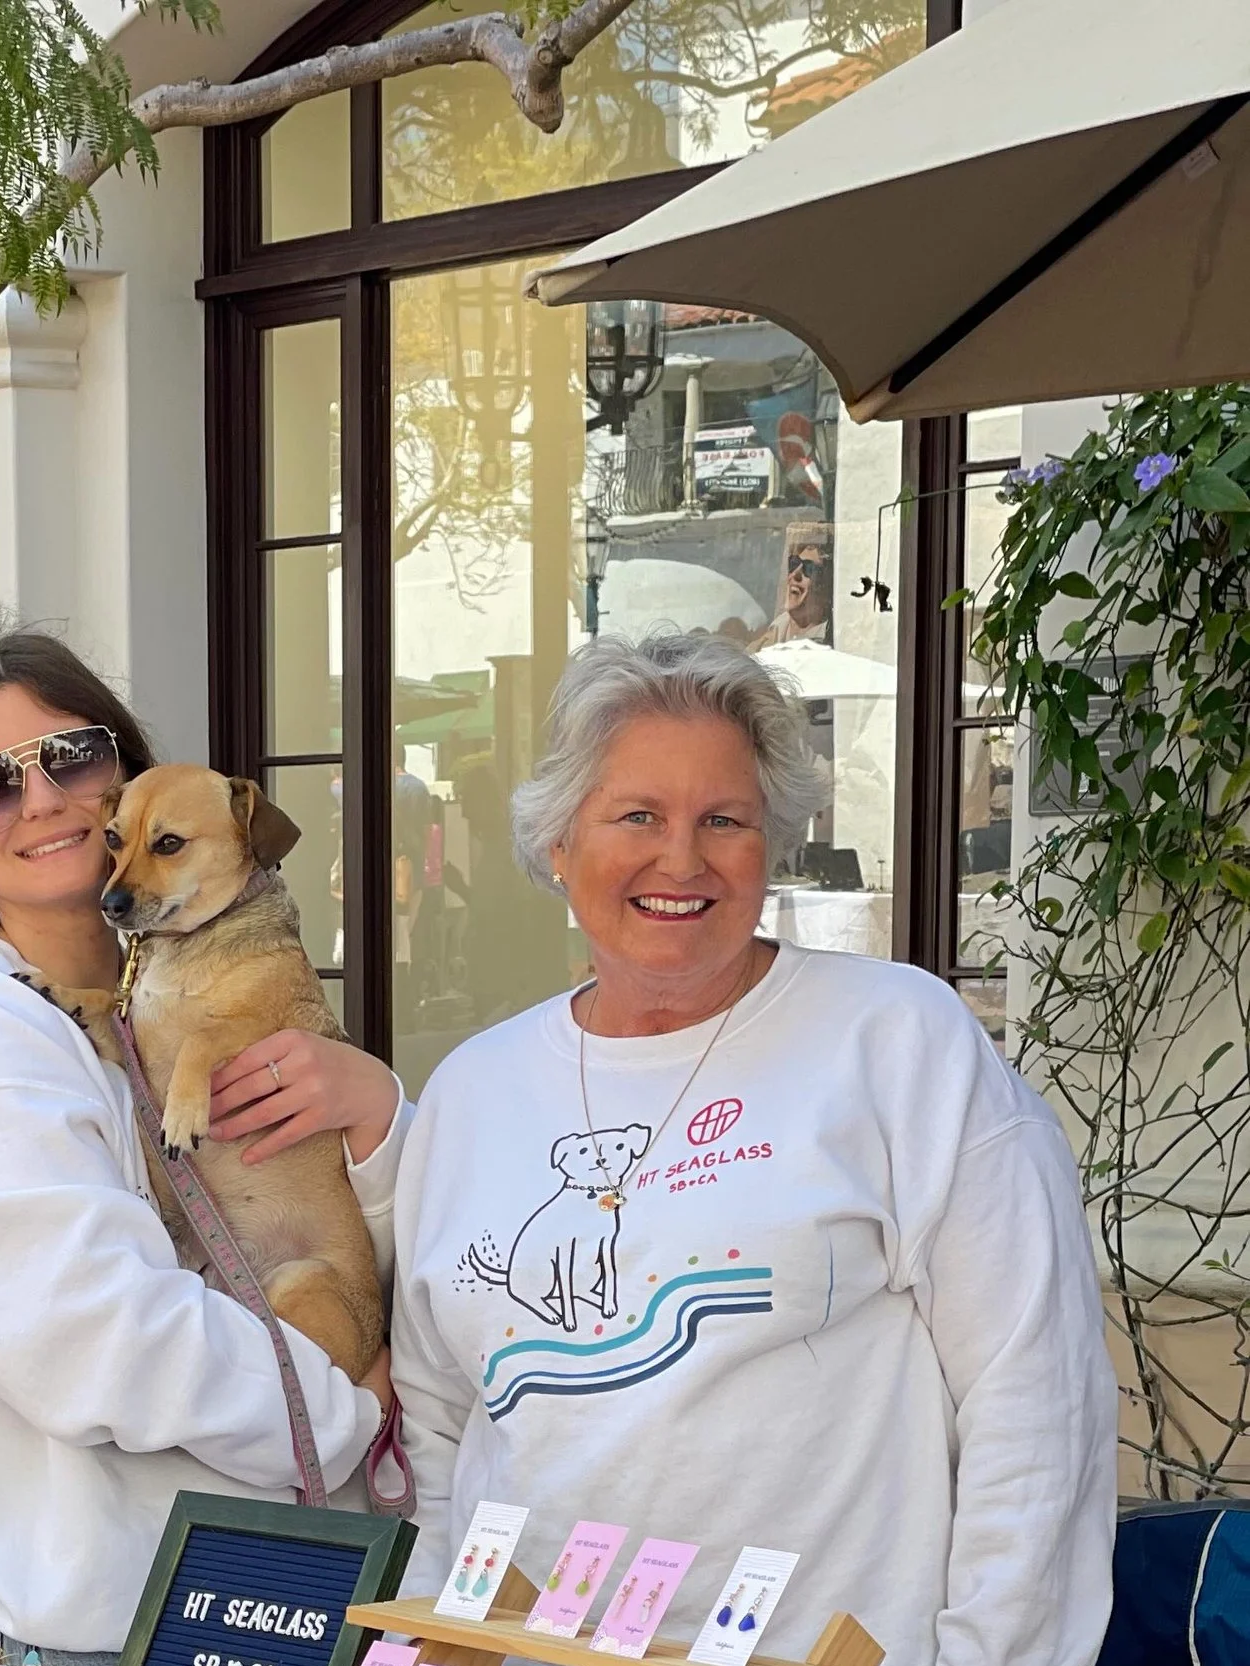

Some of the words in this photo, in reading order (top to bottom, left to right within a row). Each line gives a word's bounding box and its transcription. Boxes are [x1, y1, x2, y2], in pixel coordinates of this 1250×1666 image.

[637, 1169, 660, 1190] HT
[665, 1143, 773, 1179] SEAGLASS
[669, 1180, 687, 1193] SB
[698, 1173, 718, 1186] CA
[183, 1592, 216, 1621] HT
[223, 1599, 328, 1641] SEAGLASS
